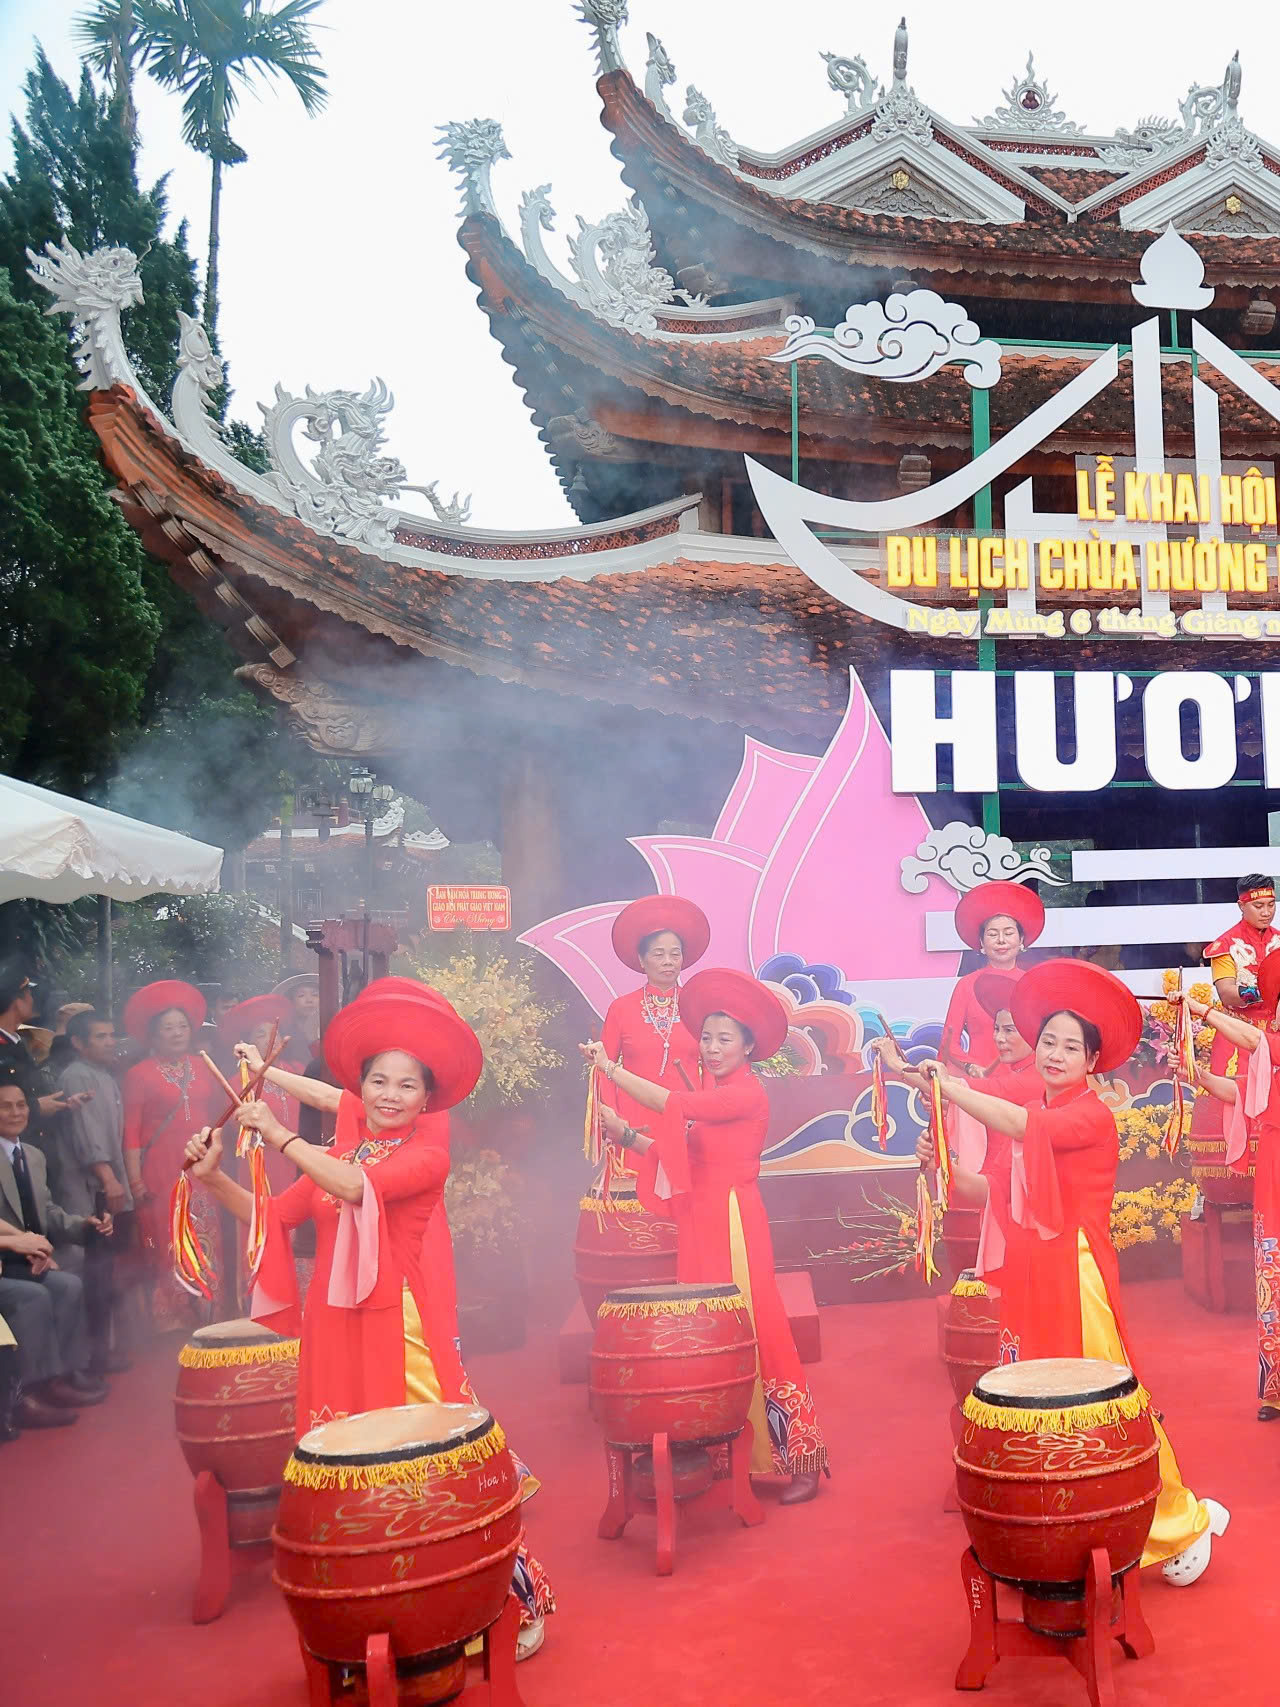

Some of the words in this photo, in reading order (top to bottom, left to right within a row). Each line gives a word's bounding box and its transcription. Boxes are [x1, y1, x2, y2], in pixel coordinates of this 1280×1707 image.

[1077, 455, 1114, 522] LỄ
[1124, 472, 1211, 525] KHAI
[1219, 466, 1278, 534] HỘI
[887, 536, 937, 589] DU
[950, 538, 1029, 597] LỊCH
[1039, 529, 1138, 592] CHÙA
[1147, 538, 1268, 594] HƯƠNG
[907, 607, 979, 636] Ngày
[987, 609, 1064, 636] Mùng
[1071, 610, 1091, 634] 6
[1099, 607, 1176, 637] tháng
[1183, 610, 1259, 637] Giêng
